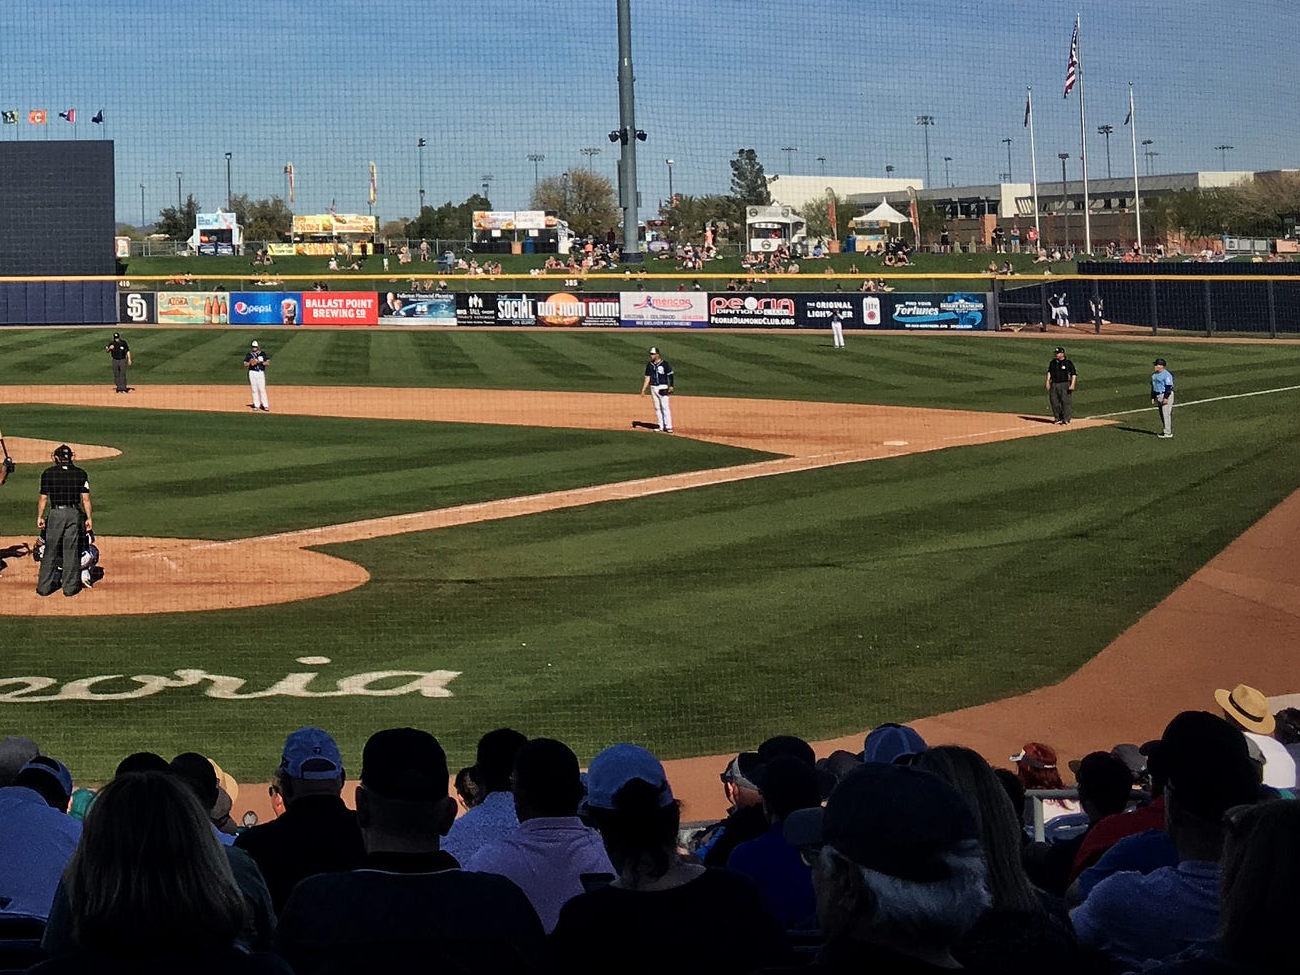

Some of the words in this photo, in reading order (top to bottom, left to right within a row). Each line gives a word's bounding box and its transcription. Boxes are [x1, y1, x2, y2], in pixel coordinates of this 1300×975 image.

[127, 293, 147, 322] SD
[248, 303, 272, 313] pepsi
[305, 299, 344, 308] BALLAST
[346, 299, 373, 308] POINT
[498, 299, 535, 319] SOCIAL
[313, 309, 354, 318] BREWING
[895, 304, 939, 316] Fortunes
